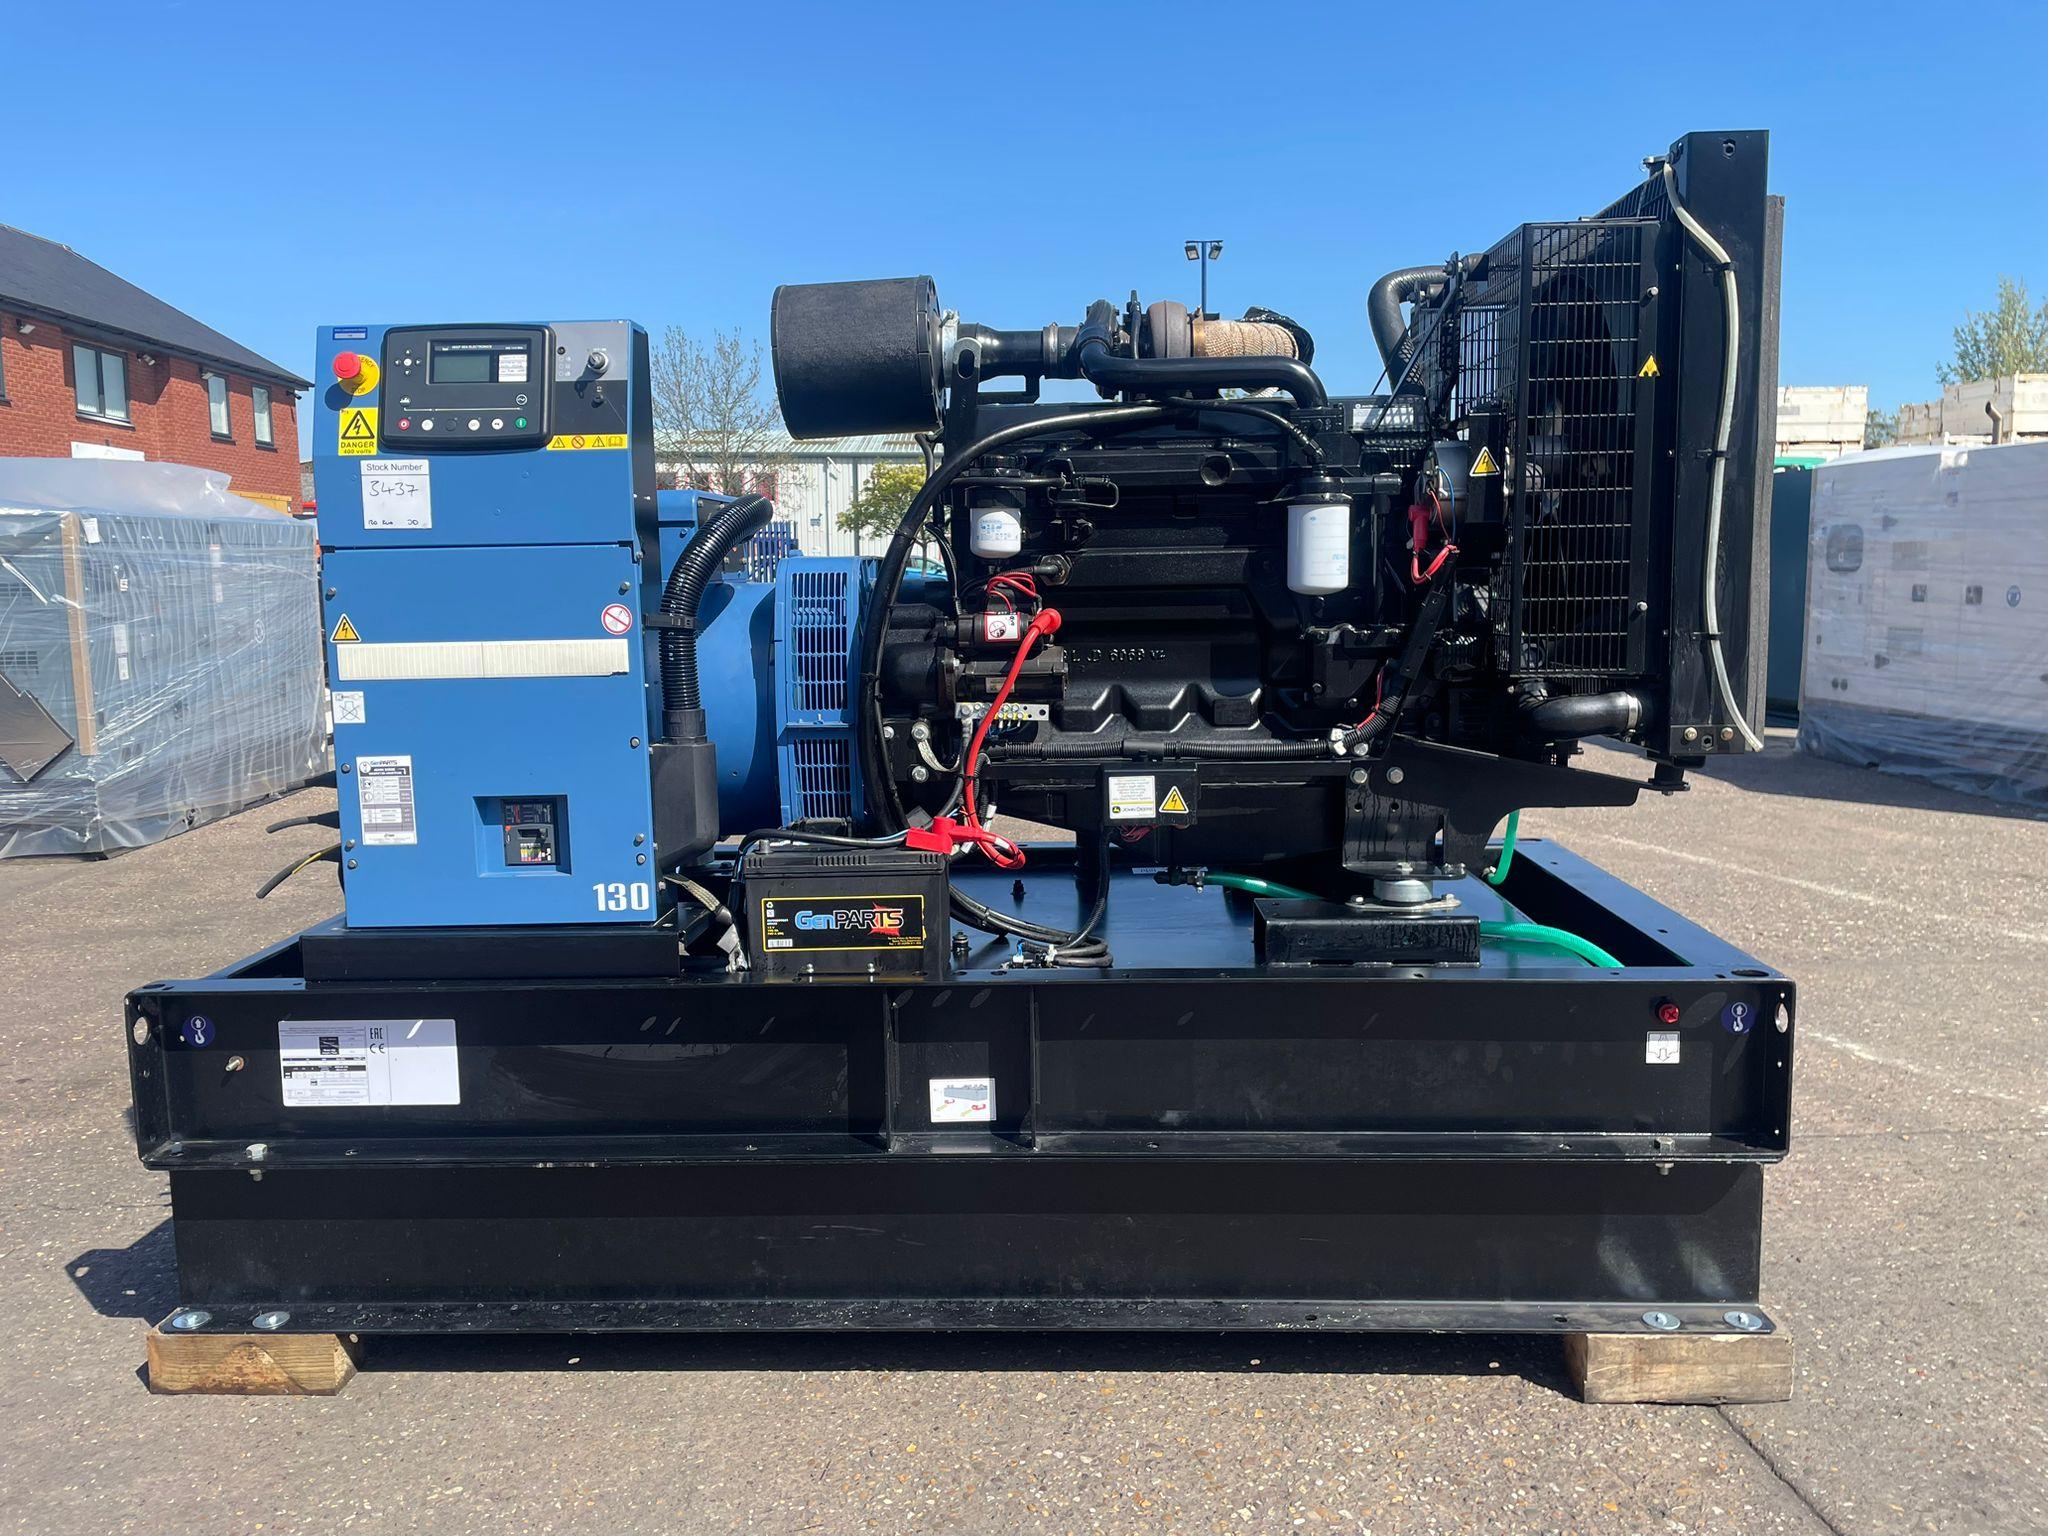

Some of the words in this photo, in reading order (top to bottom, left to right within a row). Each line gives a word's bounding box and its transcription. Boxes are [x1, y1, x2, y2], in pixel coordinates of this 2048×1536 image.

[366, 463, 389, 471] Stock
[390, 463, 423, 471] Number
[369, 480, 419, 498] 3437
[592, 882, 650, 912] 130
[794, 908, 905, 930] GenPARTS
